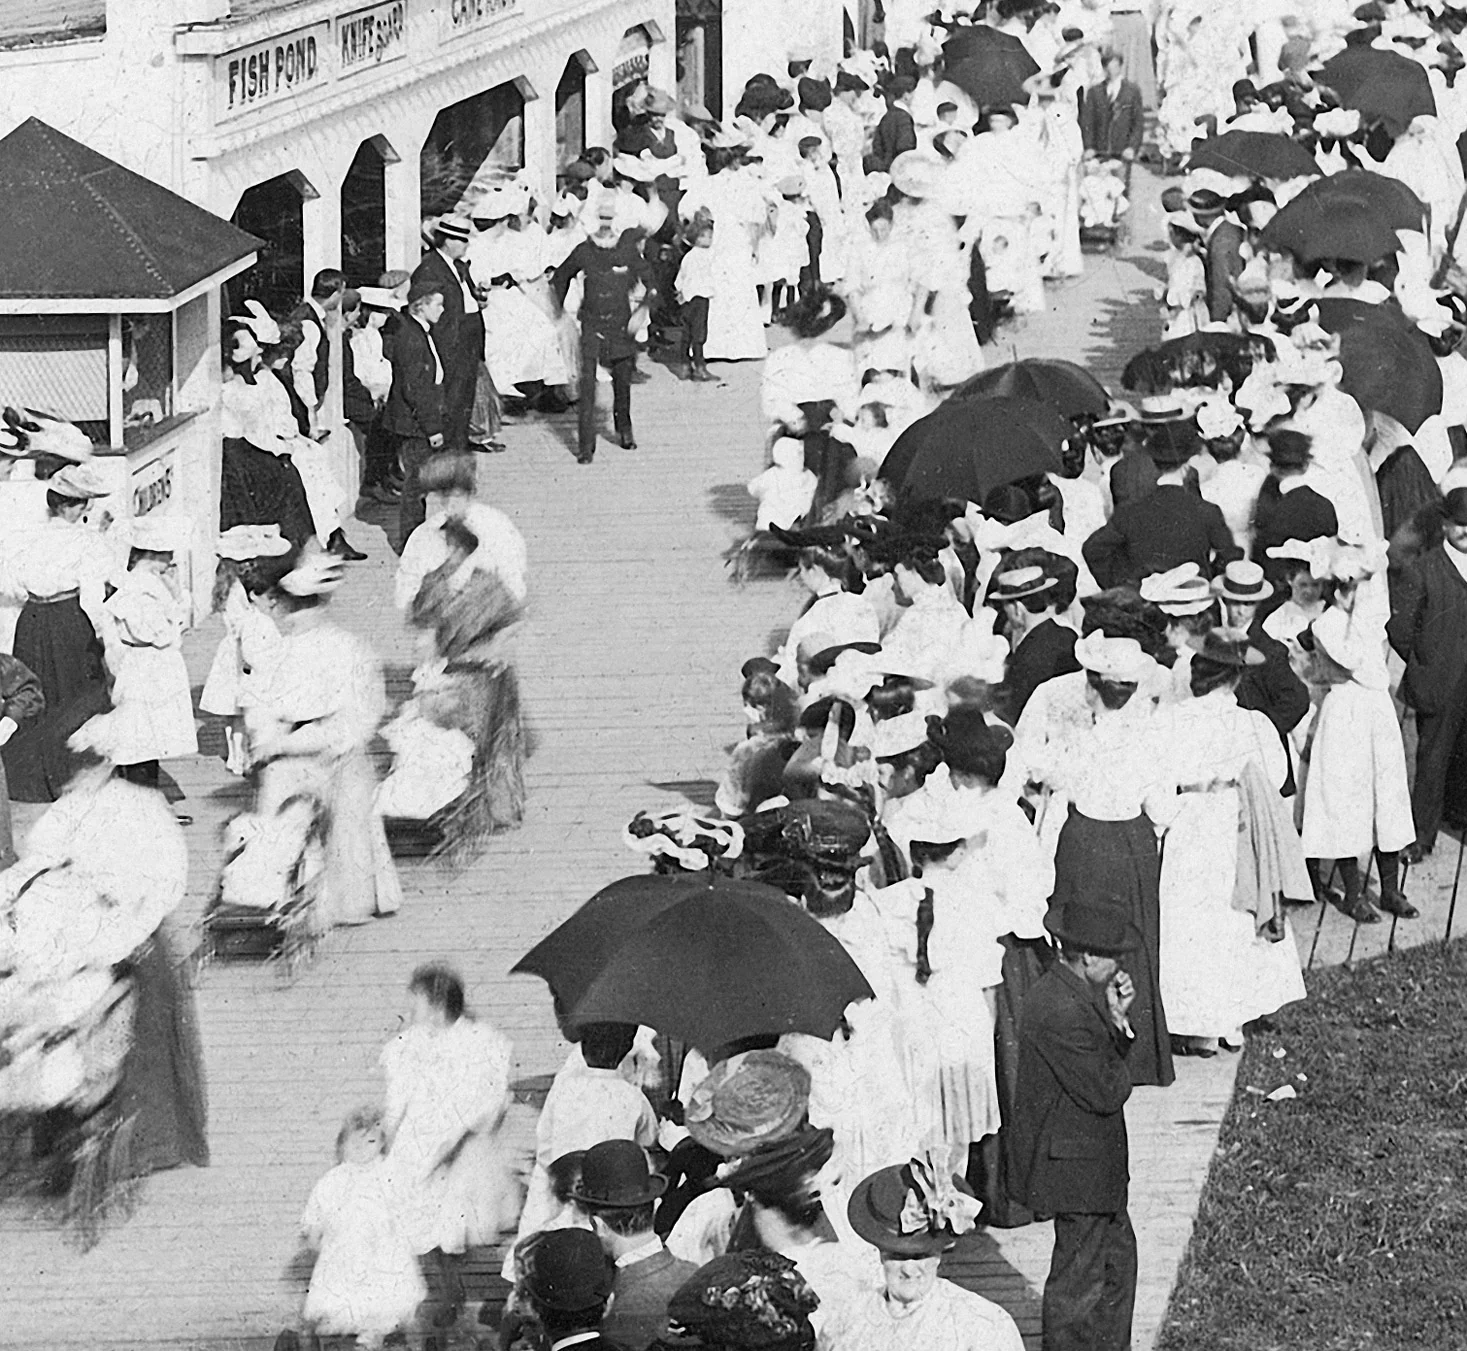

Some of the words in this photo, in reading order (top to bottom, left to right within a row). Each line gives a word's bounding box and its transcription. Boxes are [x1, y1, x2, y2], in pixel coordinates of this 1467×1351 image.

[341, 15, 375, 66] KNIFE
[227, 49, 270, 109] FISH
[275, 35, 317, 93] POND
